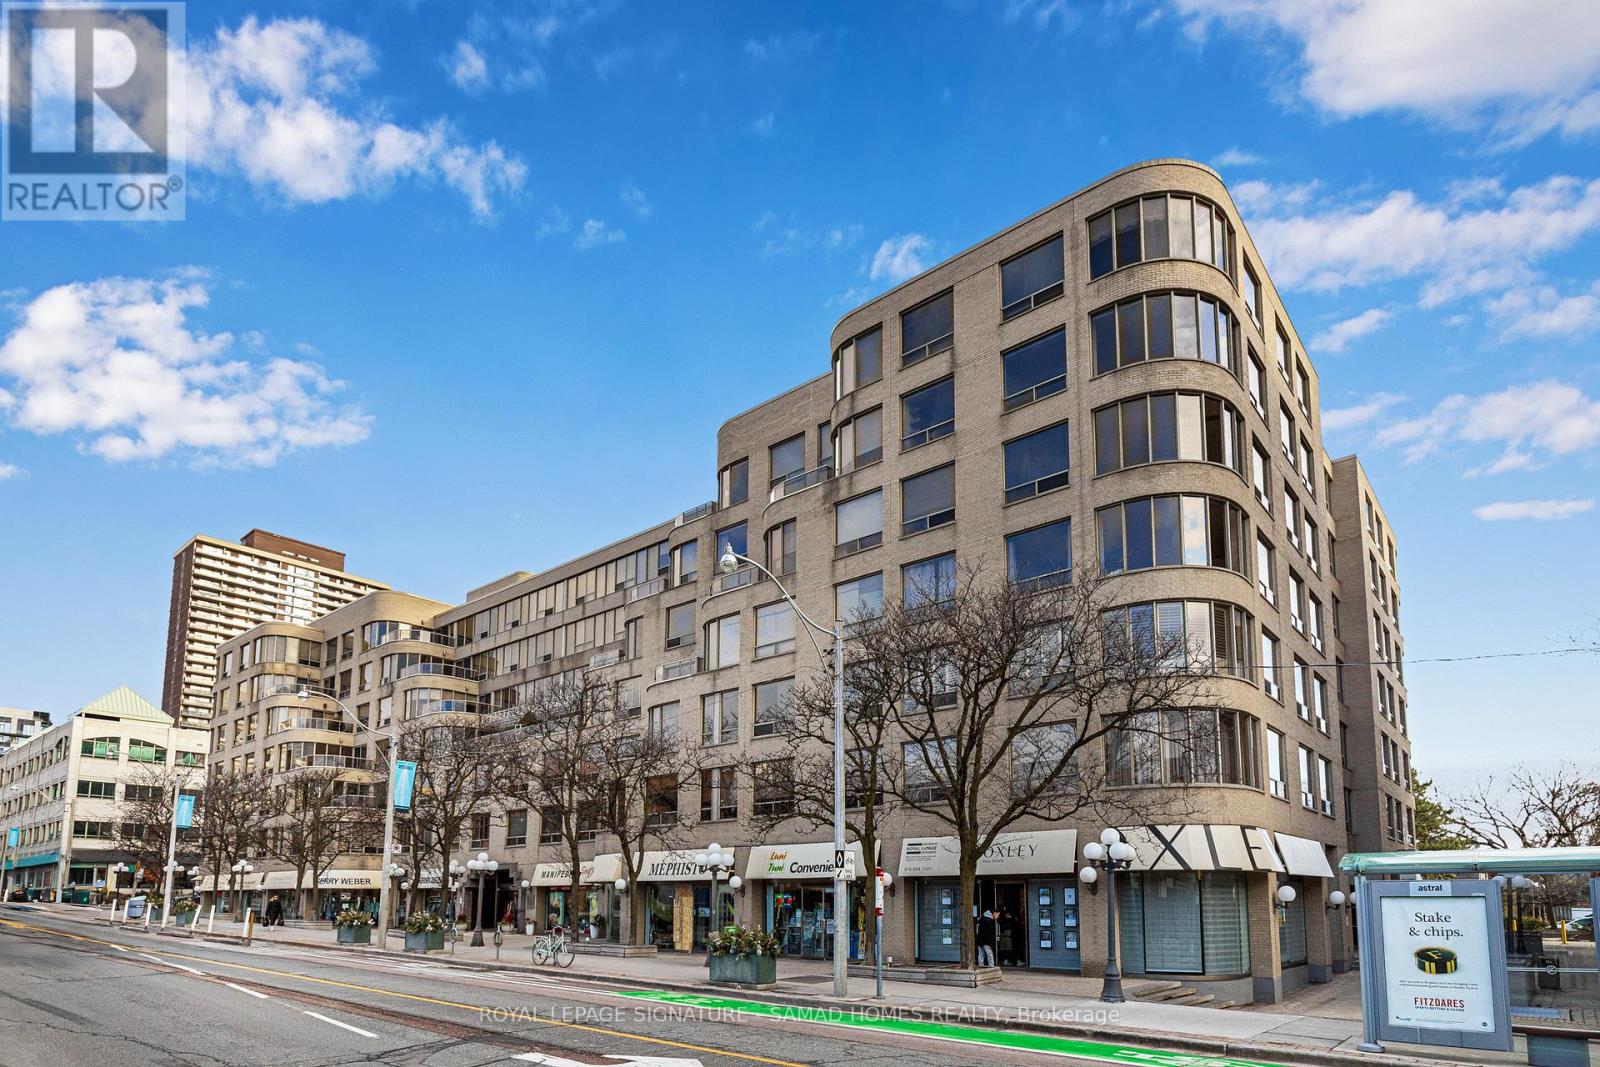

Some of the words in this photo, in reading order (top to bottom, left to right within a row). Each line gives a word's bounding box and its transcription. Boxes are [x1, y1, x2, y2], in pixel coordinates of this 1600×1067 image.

[983, 844, 1039, 859] OXLEY
[789, 859, 834, 873] Convenie
[340, 877, 371, 885] WEBER
[1414, 912, 1451, 922] Stake
[1409, 927, 1420, 936] &
[1424, 926, 1464, 940] chips.
[1414, 997, 1465, 1008] FITZDARES
